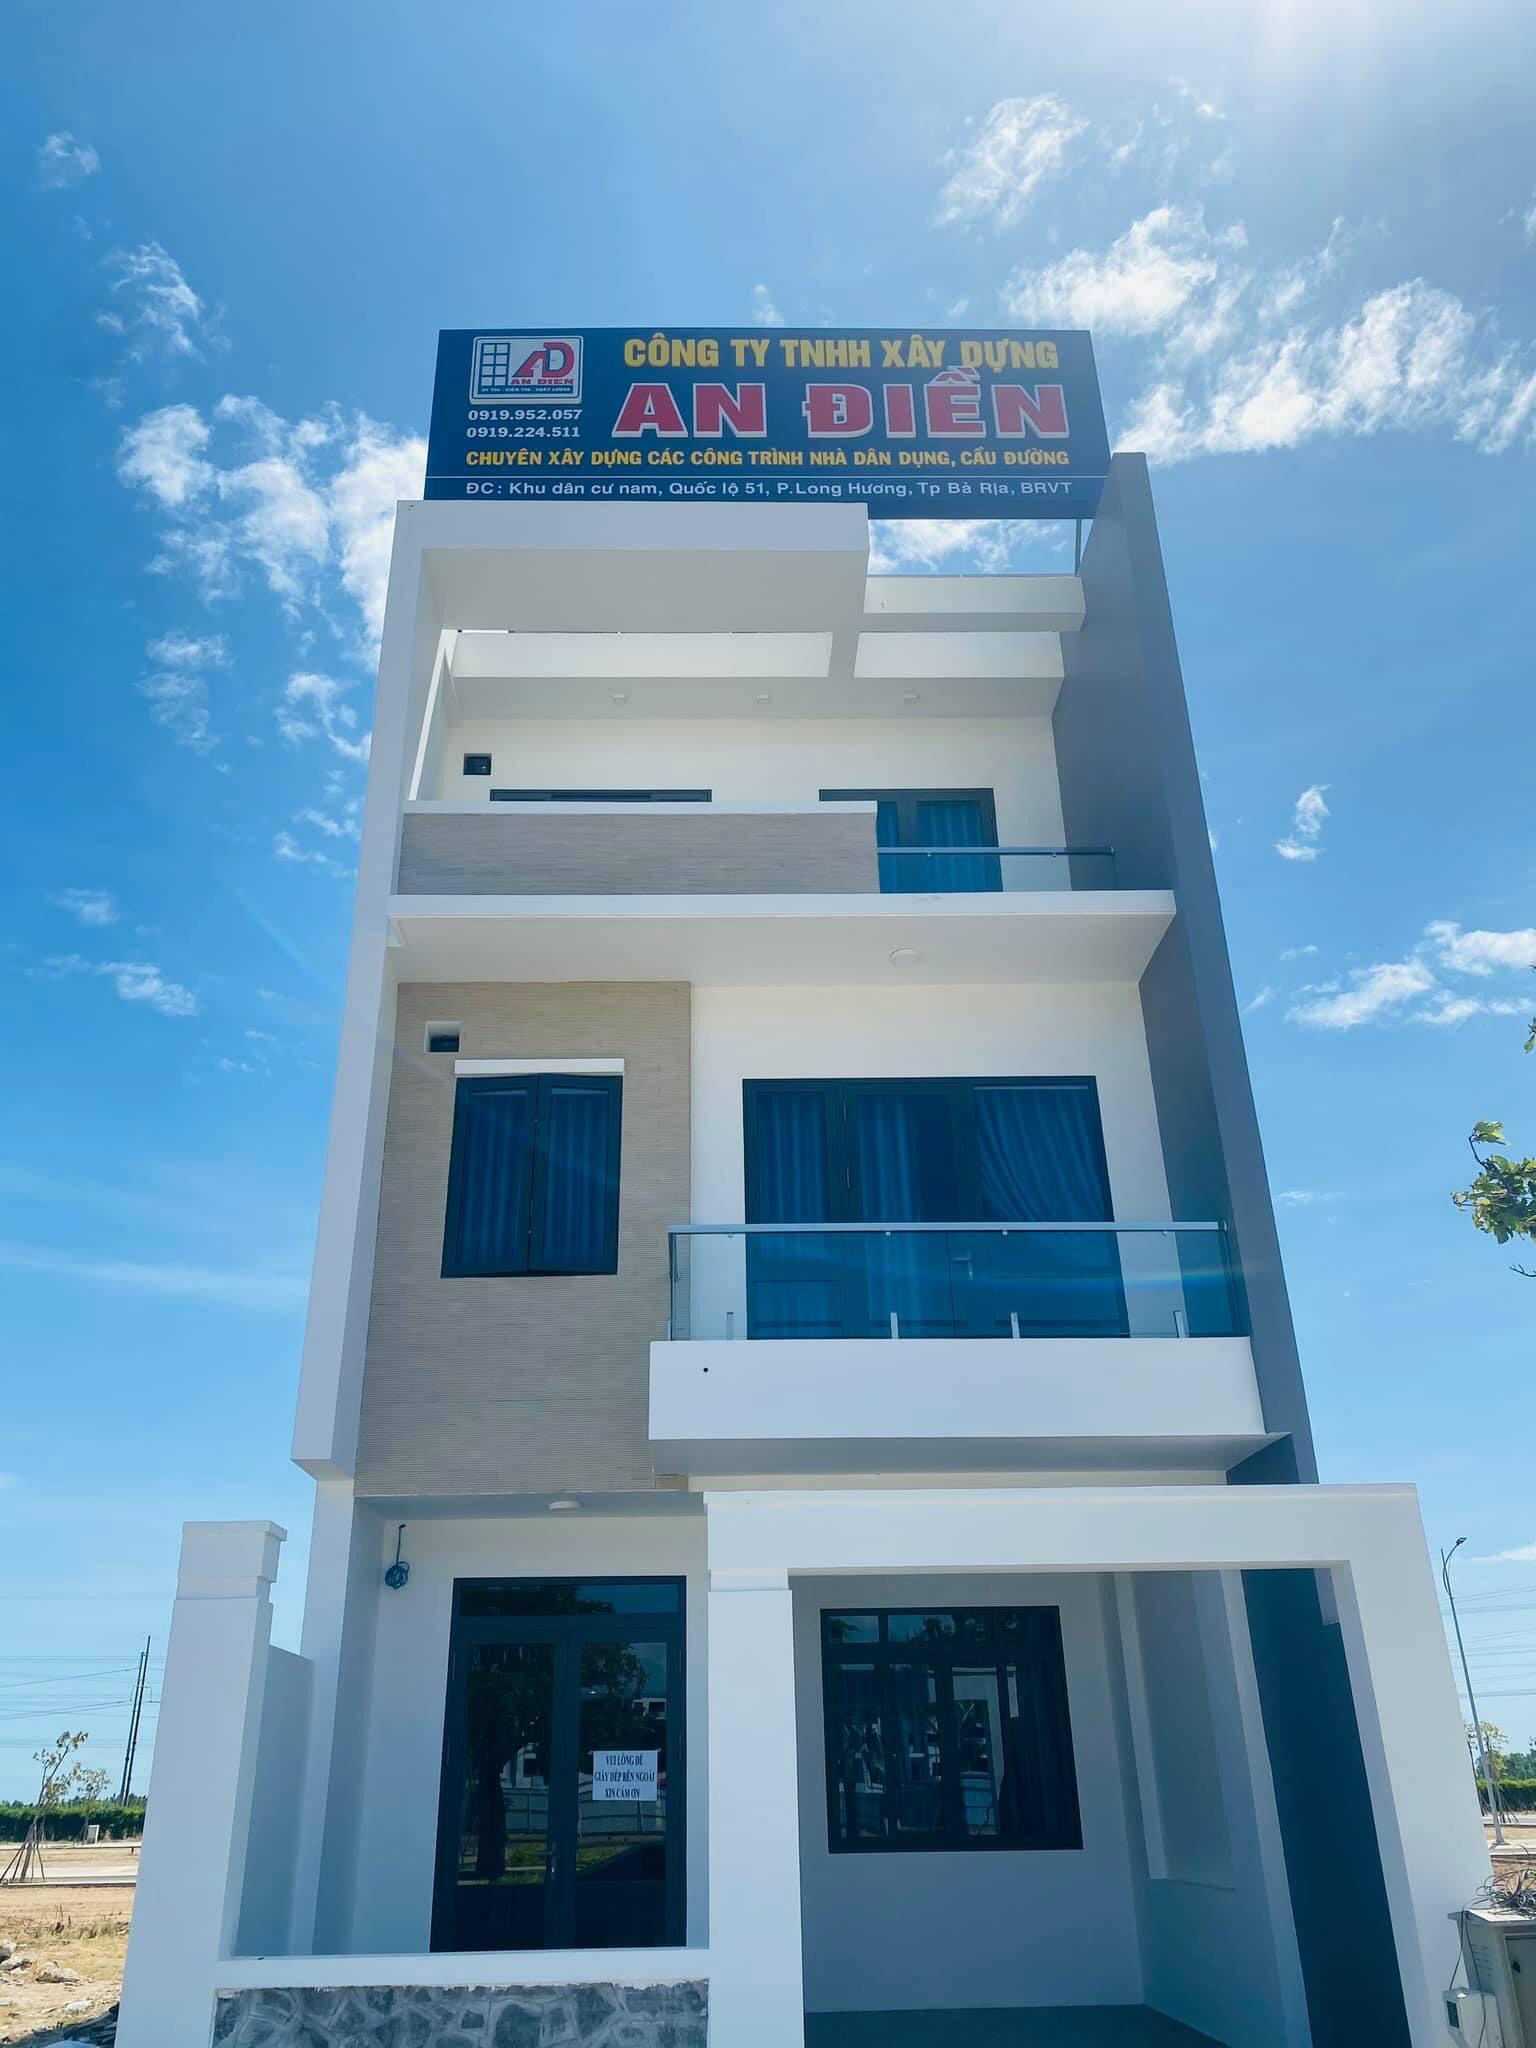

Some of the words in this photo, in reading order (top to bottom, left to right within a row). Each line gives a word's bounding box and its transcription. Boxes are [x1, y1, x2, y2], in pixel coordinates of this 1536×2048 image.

[624, 332, 719, 368] CÔNG
[730, 338, 770, 368] TY
[780, 338, 871, 368] TNHH
[881, 334, 946, 368] XÂY
[960, 338, 1059, 373] DỰNG
[611, 383, 768, 438] AN
[802, 365, 1070, 438] ĐIỀN
[468, 409, 582, 420] 0919.952.057
[466, 427, 580, 437] 0919.224.511
[466, 448, 542, 465] CHUYÊN
[548, 448, 584, 465] XÂY
[591, 449, 641, 468] DỰNG
[648, 448, 684, 465] CÁC
[691, 448, 742, 465] CÔNG
[749, 448, 803, 465] TRÌNH
[810, 448, 847, 465] NHÀ
[854, 448, 891, 465] DÂN
[899, 451, 956, 468] DỤNG,
[960, 446, 996, 465] CẦU
[1004, 449, 1069, 465] ĐƯỜNG
[466, 483, 502, 495] ĐC:
[509, 483, 545, 494] Khu
[552, 482, 584, 494] dân
[591, 483, 614, 494] cư
[619, 485, 663, 496] nam,
[669, 481, 716, 494] Quốc
[722, 483, 738, 496] lộ
[745, 483, 769, 496] 51,
[777, 483, 841, 496] P.Long
[848, 482, 913, 496] Hương,
[917, 483, 940, 496] Tp
[948, 482, 972, 494] Bà
[1021, 482, 1072, 494] BRVT
